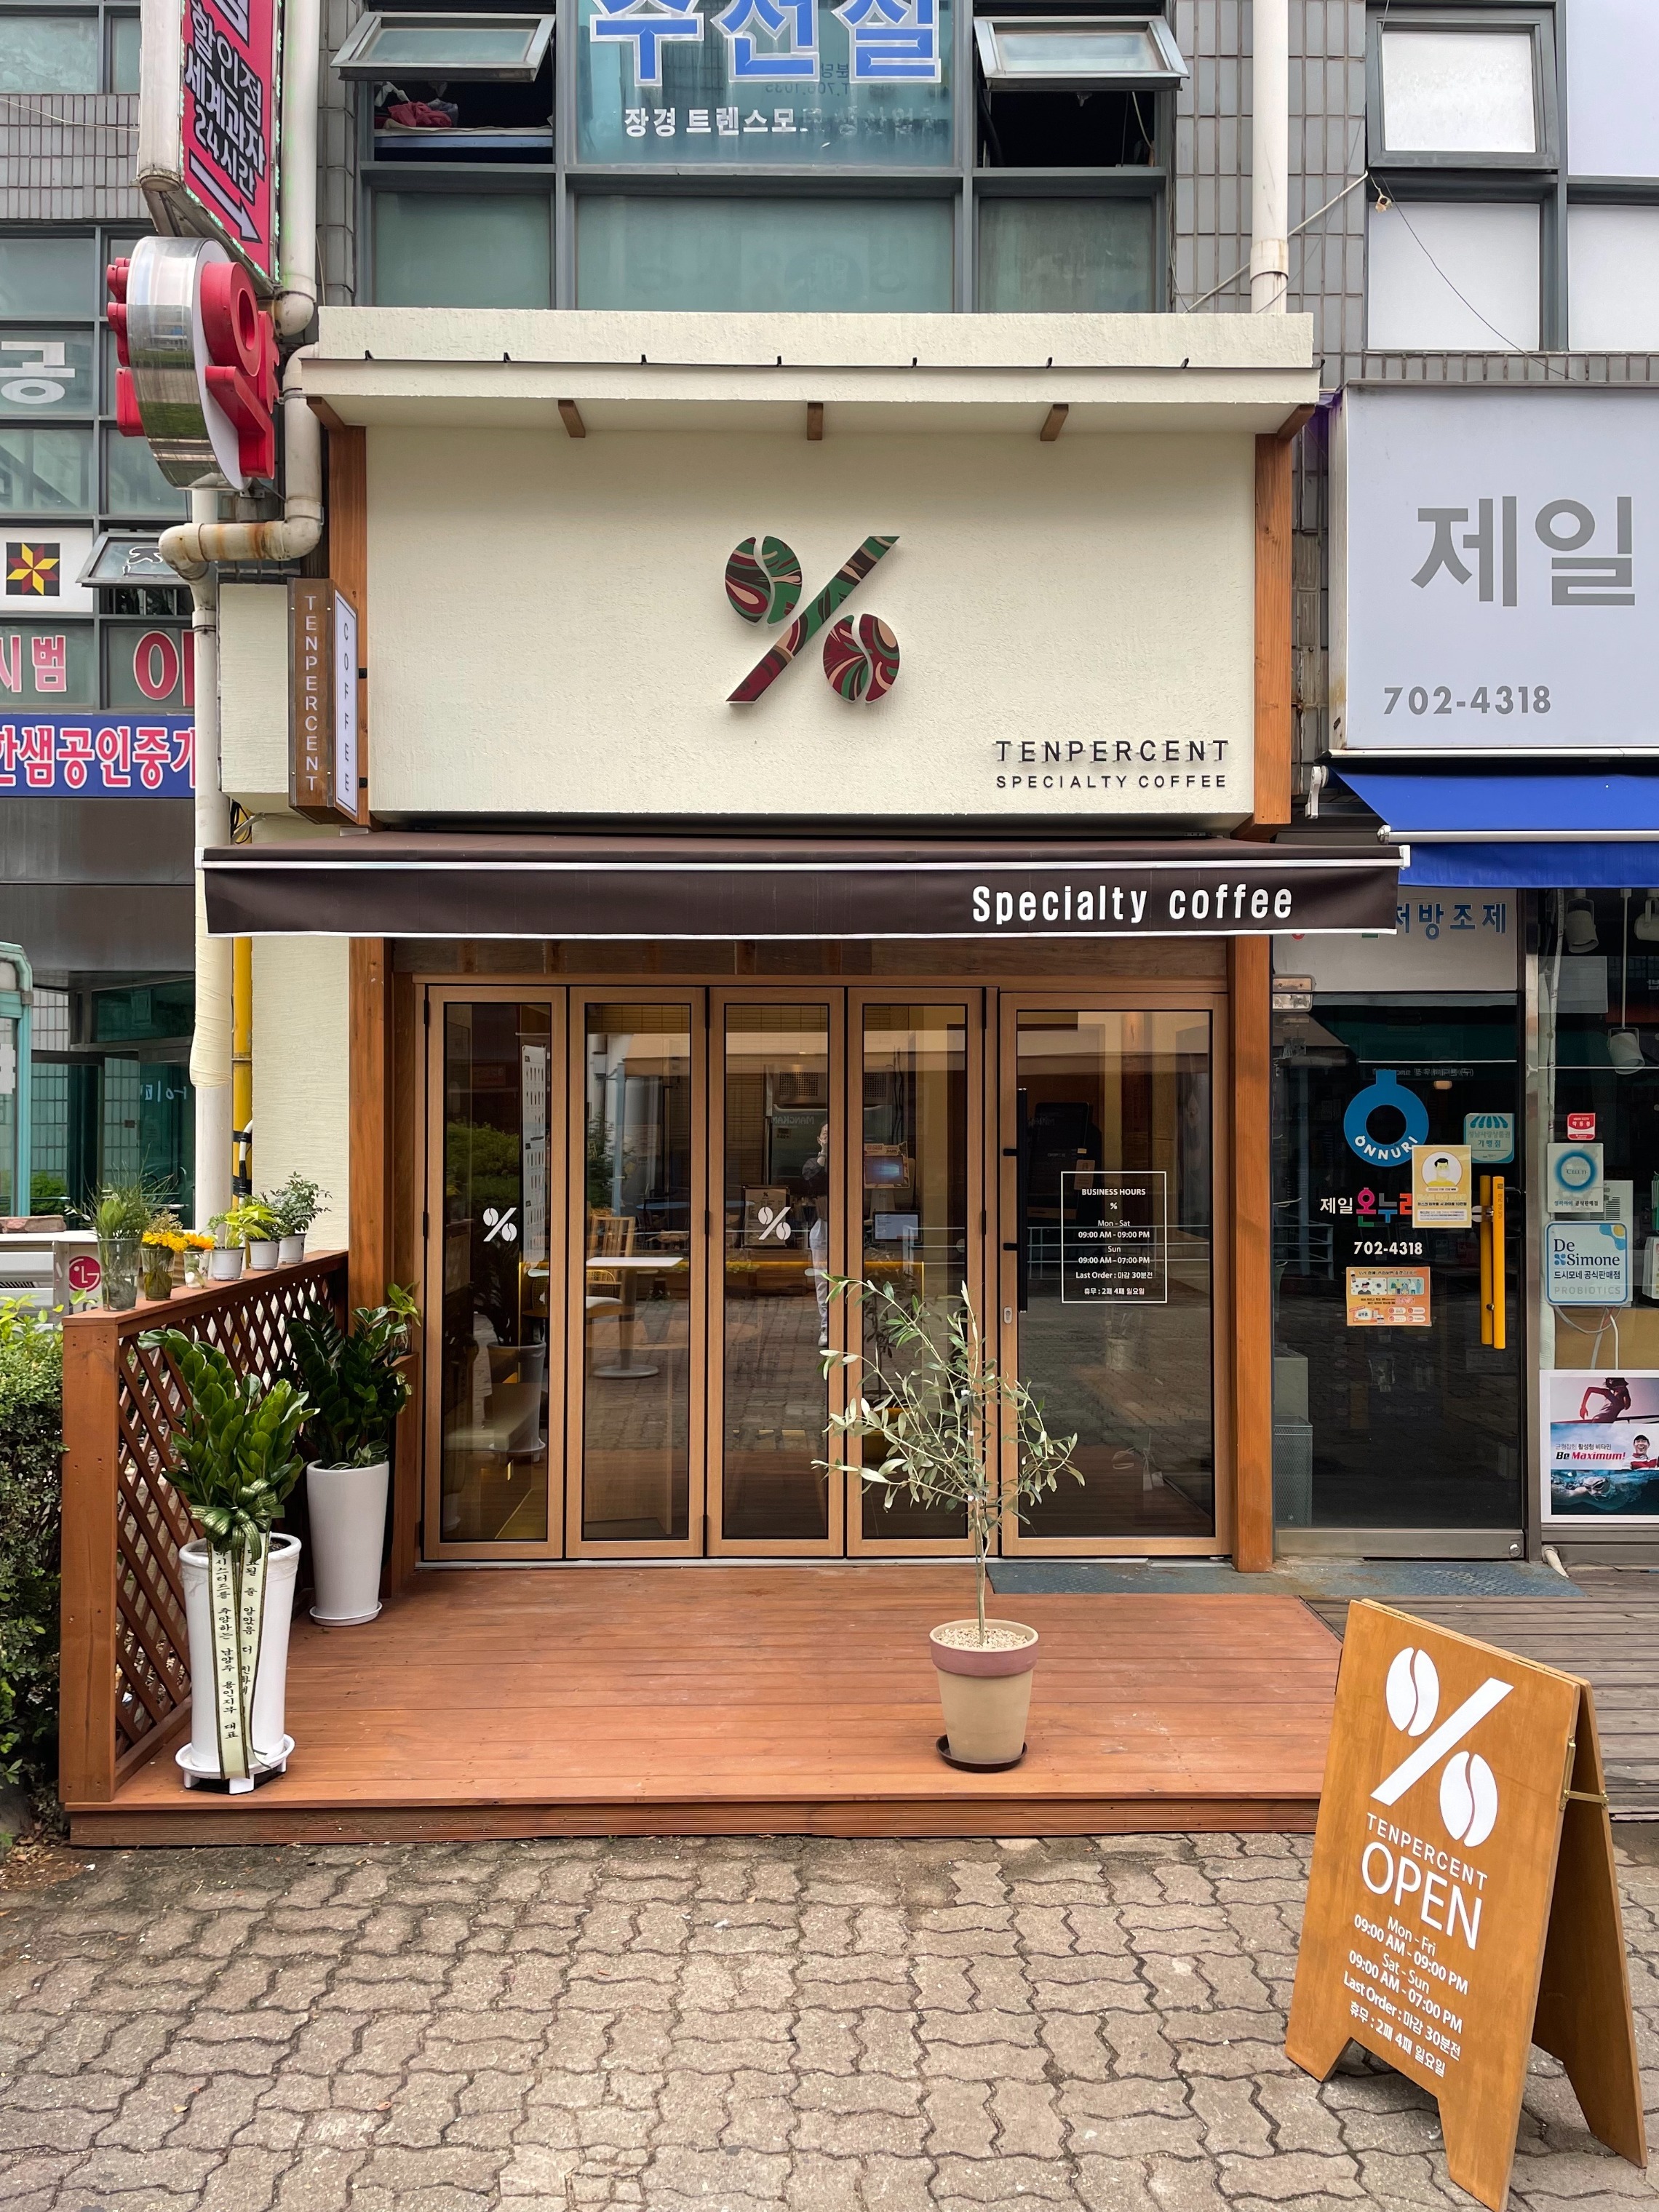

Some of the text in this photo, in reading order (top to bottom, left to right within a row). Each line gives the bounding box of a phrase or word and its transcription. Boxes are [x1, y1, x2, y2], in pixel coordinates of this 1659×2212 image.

[185, 47, 266, 177] 세계과자
[624, 108, 676, 137] 장경
[195, 105, 255, 202] 24시간
[1411, 496, 1636, 607] 제일
[304, 594, 319, 792] TENPERCENT
[1383, 685, 1551, 715] 702-4318
[995, 739, 1229, 762] TENPERCENT
[996, 775, 1226, 788] SPECIALTY COFFEE
[972, 883, 1292, 925] Specialty coffee
[1354, 1135, 1418, 1161] ONNURI
[1320, 1197, 1353, 1214] 제일
[1353, 1241, 1423, 1255] 702-4318
[1553, 1238, 1575, 1252] De
[1567, 1253, 1620, 1266] Simone
[1554, 1270, 1620, 1280] 드시모네 공식판매점
[1554, 1286, 1620, 1294] PROBIOTICS
[1556, 1452, 1626, 1460] Be Maximum!
[1366, 1812, 1488, 1891] TENPERCENT
[1361, 1842, 1482, 1951] OPEN
[1354, 1914, 1385, 1943] 09:00
[1385, 1935, 1405, 1957] AM
[1414, 1951, 1447, 1982] 09:00
[1448, 1972, 1468, 1996] PM
[1387, 1916, 1412, 1943] Mon
[1421, 1936, 1436, 1957] Fri
[1349, 1950, 1379, 1979] 09:00
[1380, 1971, 1400, 1994] AM
[1408, 1987, 1441, 2020] 07:00
[1443, 2010, 1463, 2034] PM
[1382, 1954, 1400, 1976] Sat
[1408, 1969, 1431, 1994] Sun
[1343, 1970, 1365, 1994] Last
[1366, 1987, 1397, 2018] Order
[1403, 2009, 1424, 2036] 마감
[1425, 2025, 1461, 2062] 30분전
[1349, 2000, 1369, 2024] 휴무
[1414, 2044, 1446, 2078] 일요일
